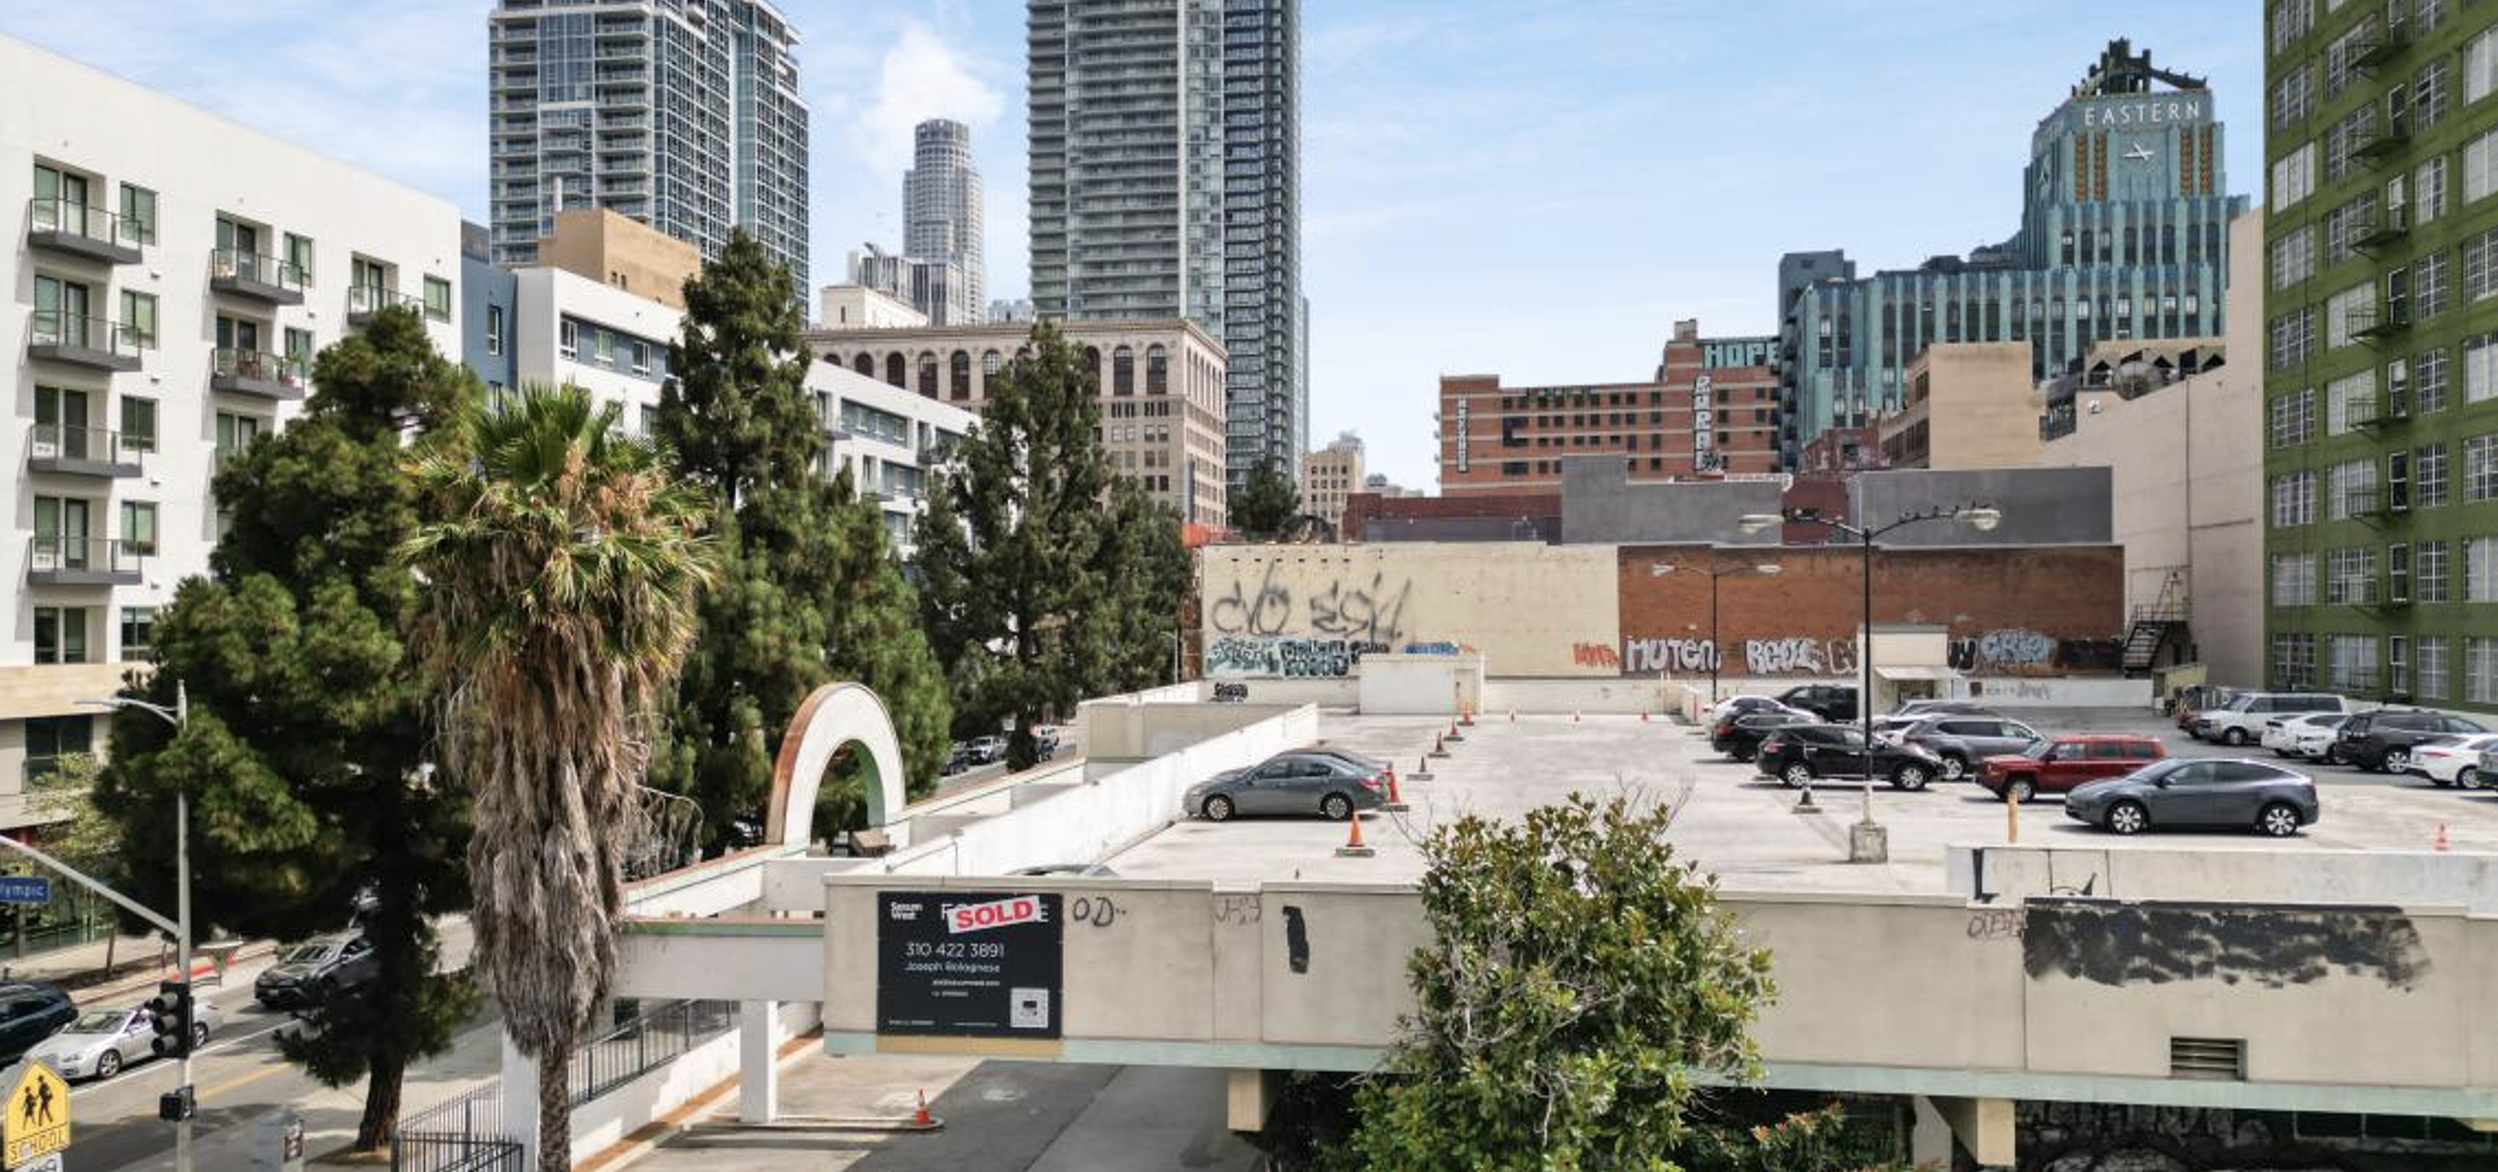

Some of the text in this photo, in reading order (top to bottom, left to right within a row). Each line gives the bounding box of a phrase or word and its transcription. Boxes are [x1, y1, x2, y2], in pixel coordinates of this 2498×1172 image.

[2084, 101, 2200, 126] EASTERN
[1704, 342, 1780, 369] HOPE
[955, 900, 1033, 929] SOLD
[905, 942, 1005, 958] 310 422 3891
[6, 1129, 68, 1162] SCHOOL
